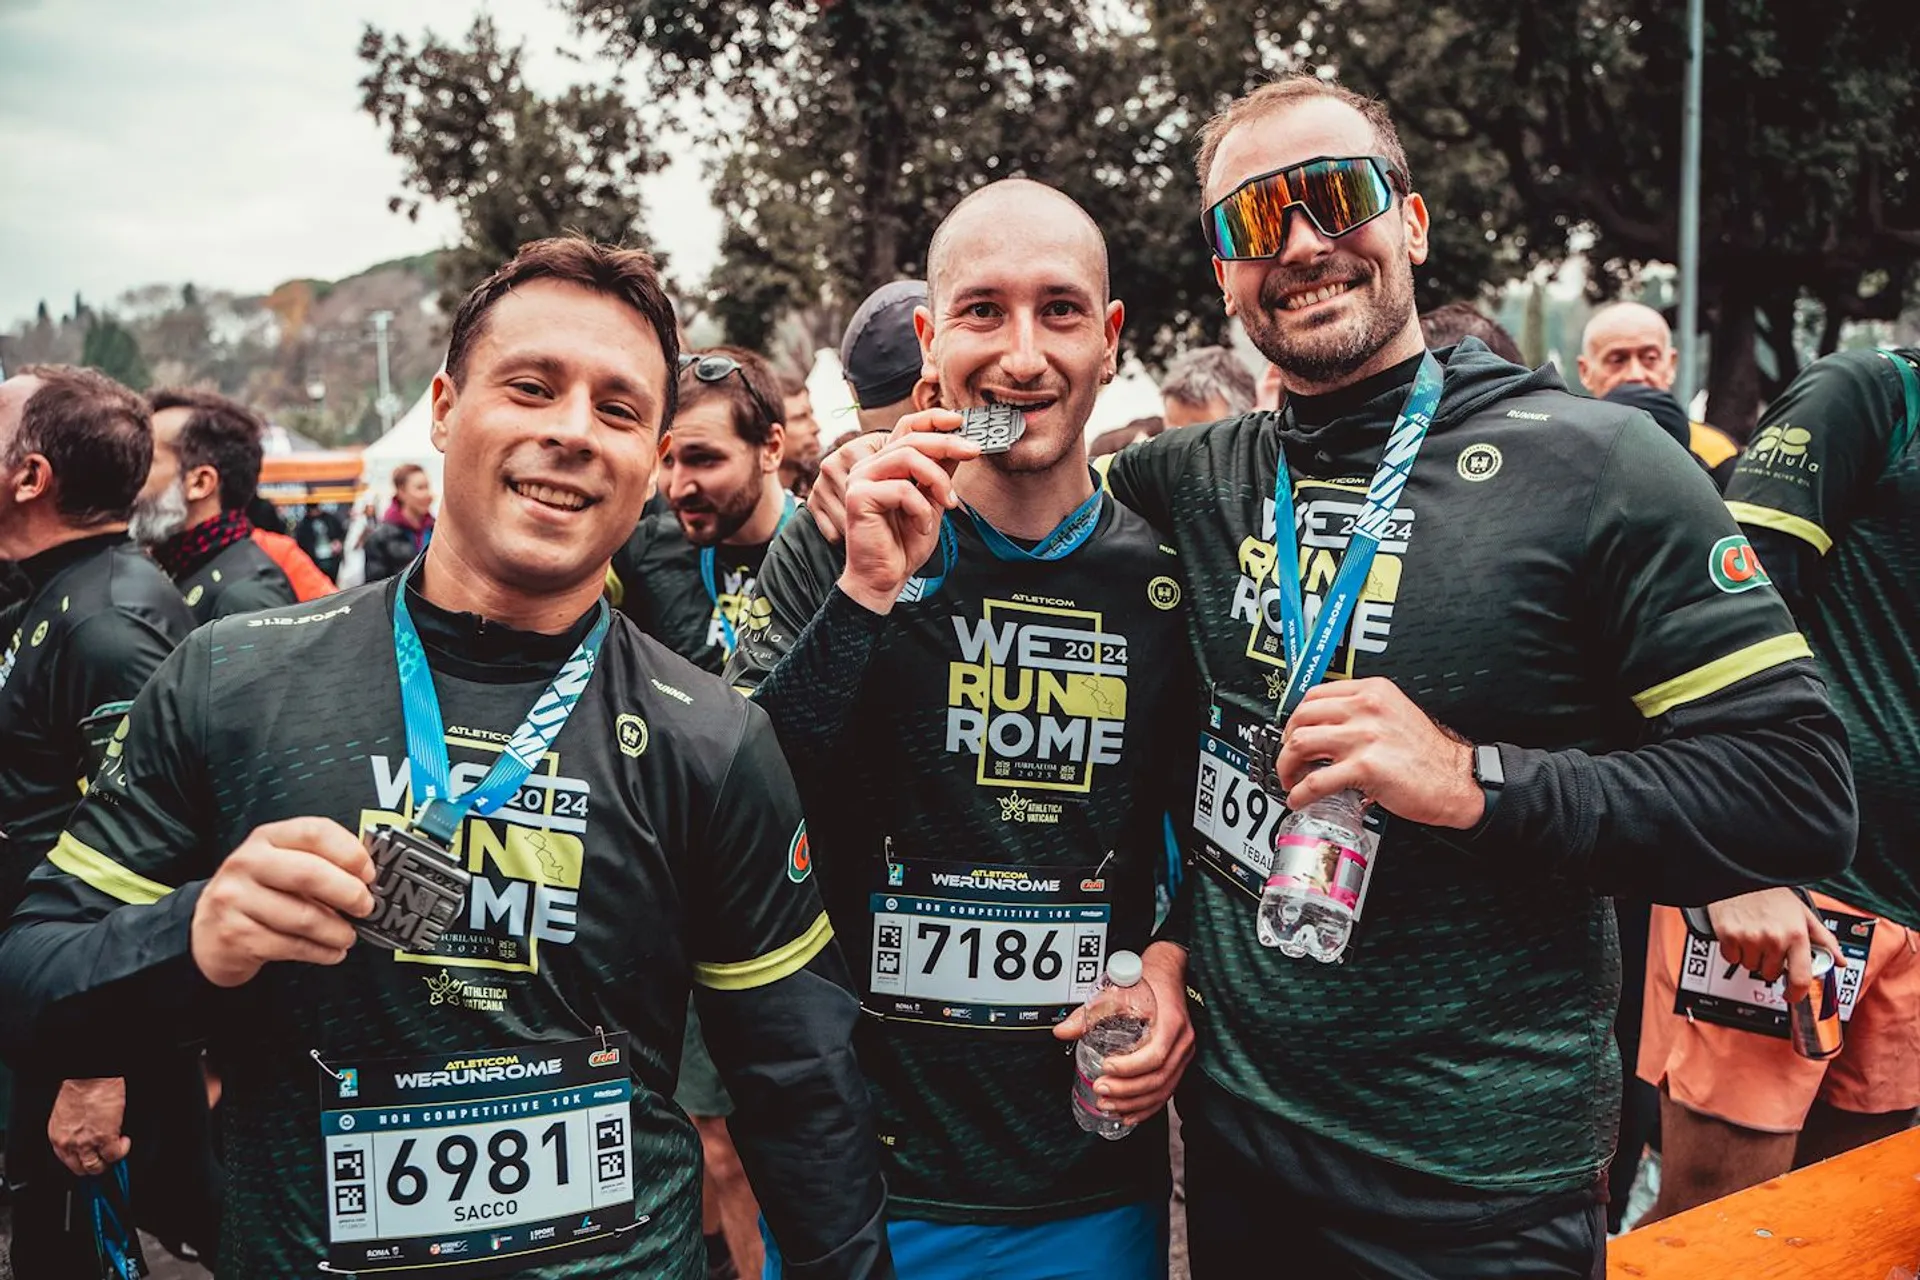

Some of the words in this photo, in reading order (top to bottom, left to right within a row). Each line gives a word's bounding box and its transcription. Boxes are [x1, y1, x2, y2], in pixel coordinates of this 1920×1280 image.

[1340, 517, 1412, 540] 224
[1011, 593, 1075, 608] ATLETICOM
[951, 615, 1128, 677] WE
[1065, 641, 1128, 664] 2024
[1298, 654, 1323, 694] ROMA
[948, 661, 1127, 721] RUN
[448, 725, 511, 743] ATLETICO
[946, 707, 1125, 765] ROME
[507, 788, 589, 817] 2024
[1027, 803, 1063, 813] ATHLETICA
[1026, 813, 1059, 823] VATICANA
[931, 873, 1061, 892] WERUNROME
[971, 869, 1028, 880] ATLETICOM
[916, 902, 941, 912] NON
[950, 905, 1040, 919] COMPETITIVE
[1049, 909, 1072, 919] 10K
[917, 922, 1063, 981] 7186
[462, 985, 508, 1000] ATHLETICA
[395, 1058, 563, 1089] WERUNROME
[444, 1055, 519, 1070] ATLETICOM
[379, 1112, 411, 1125] NON
[423, 1100, 540, 1122] COMPETITIVE
[552, 1094, 582, 1107] 10K
[386, 1120, 569, 1206] 6981
[454, 1199, 518, 1222] SACCO
